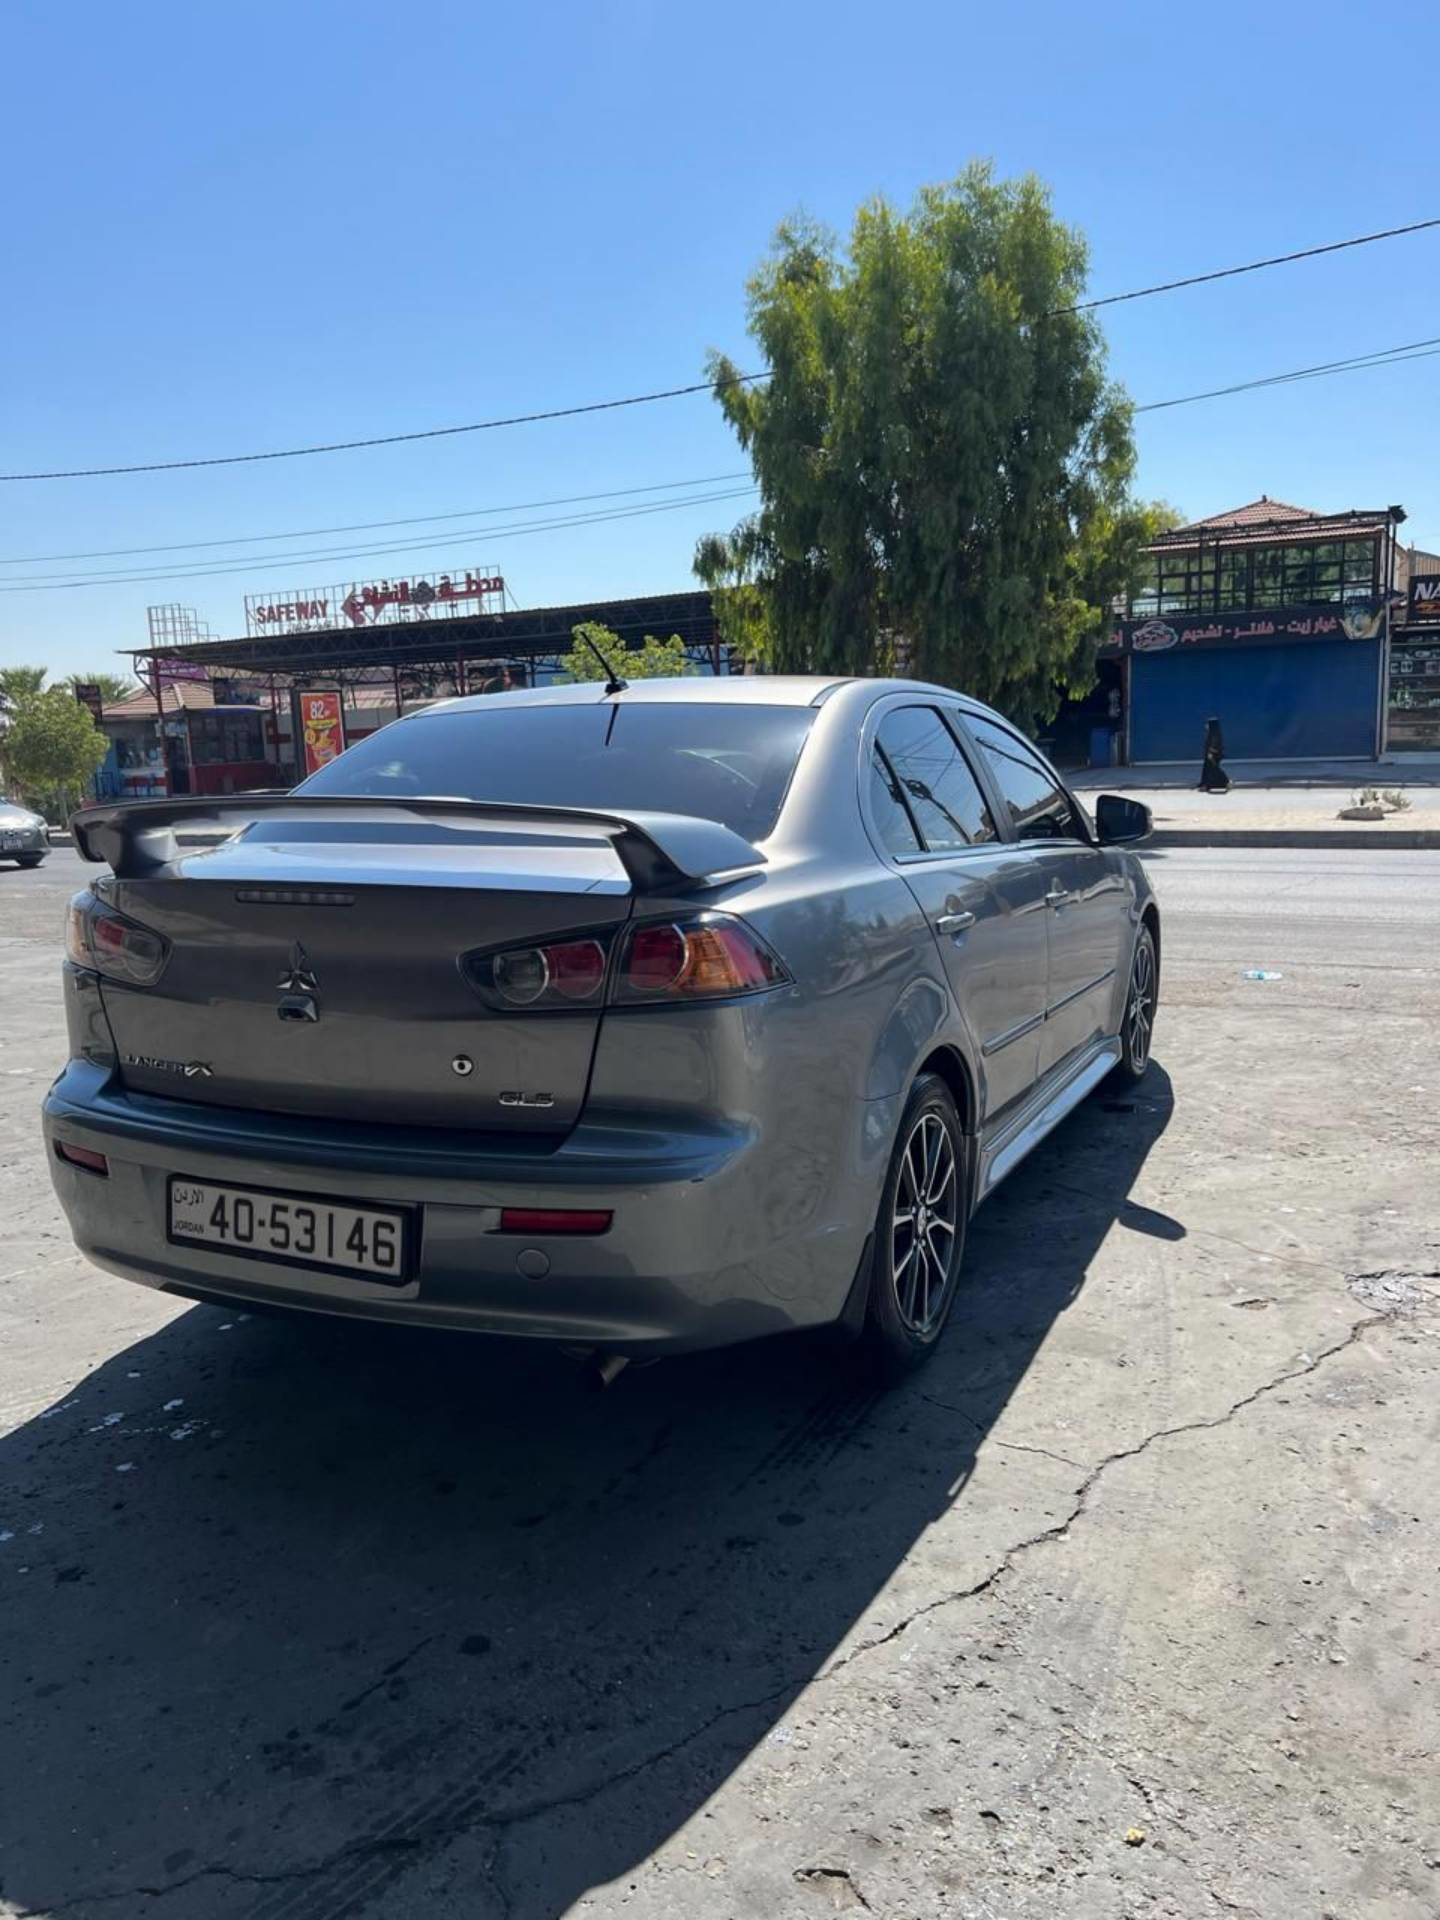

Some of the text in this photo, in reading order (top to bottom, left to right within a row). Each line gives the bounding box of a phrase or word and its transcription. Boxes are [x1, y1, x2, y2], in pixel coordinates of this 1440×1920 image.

[256, 600, 328, 624] SAFEWAY
[1313, 616, 1338, 634] غيار
[310, 700, 324, 720] 82
[498, 1090, 554, 1108] GLS
[173, 1221, 205, 1235] JORDAN
[209, 1193, 396, 1268] 40-53146
